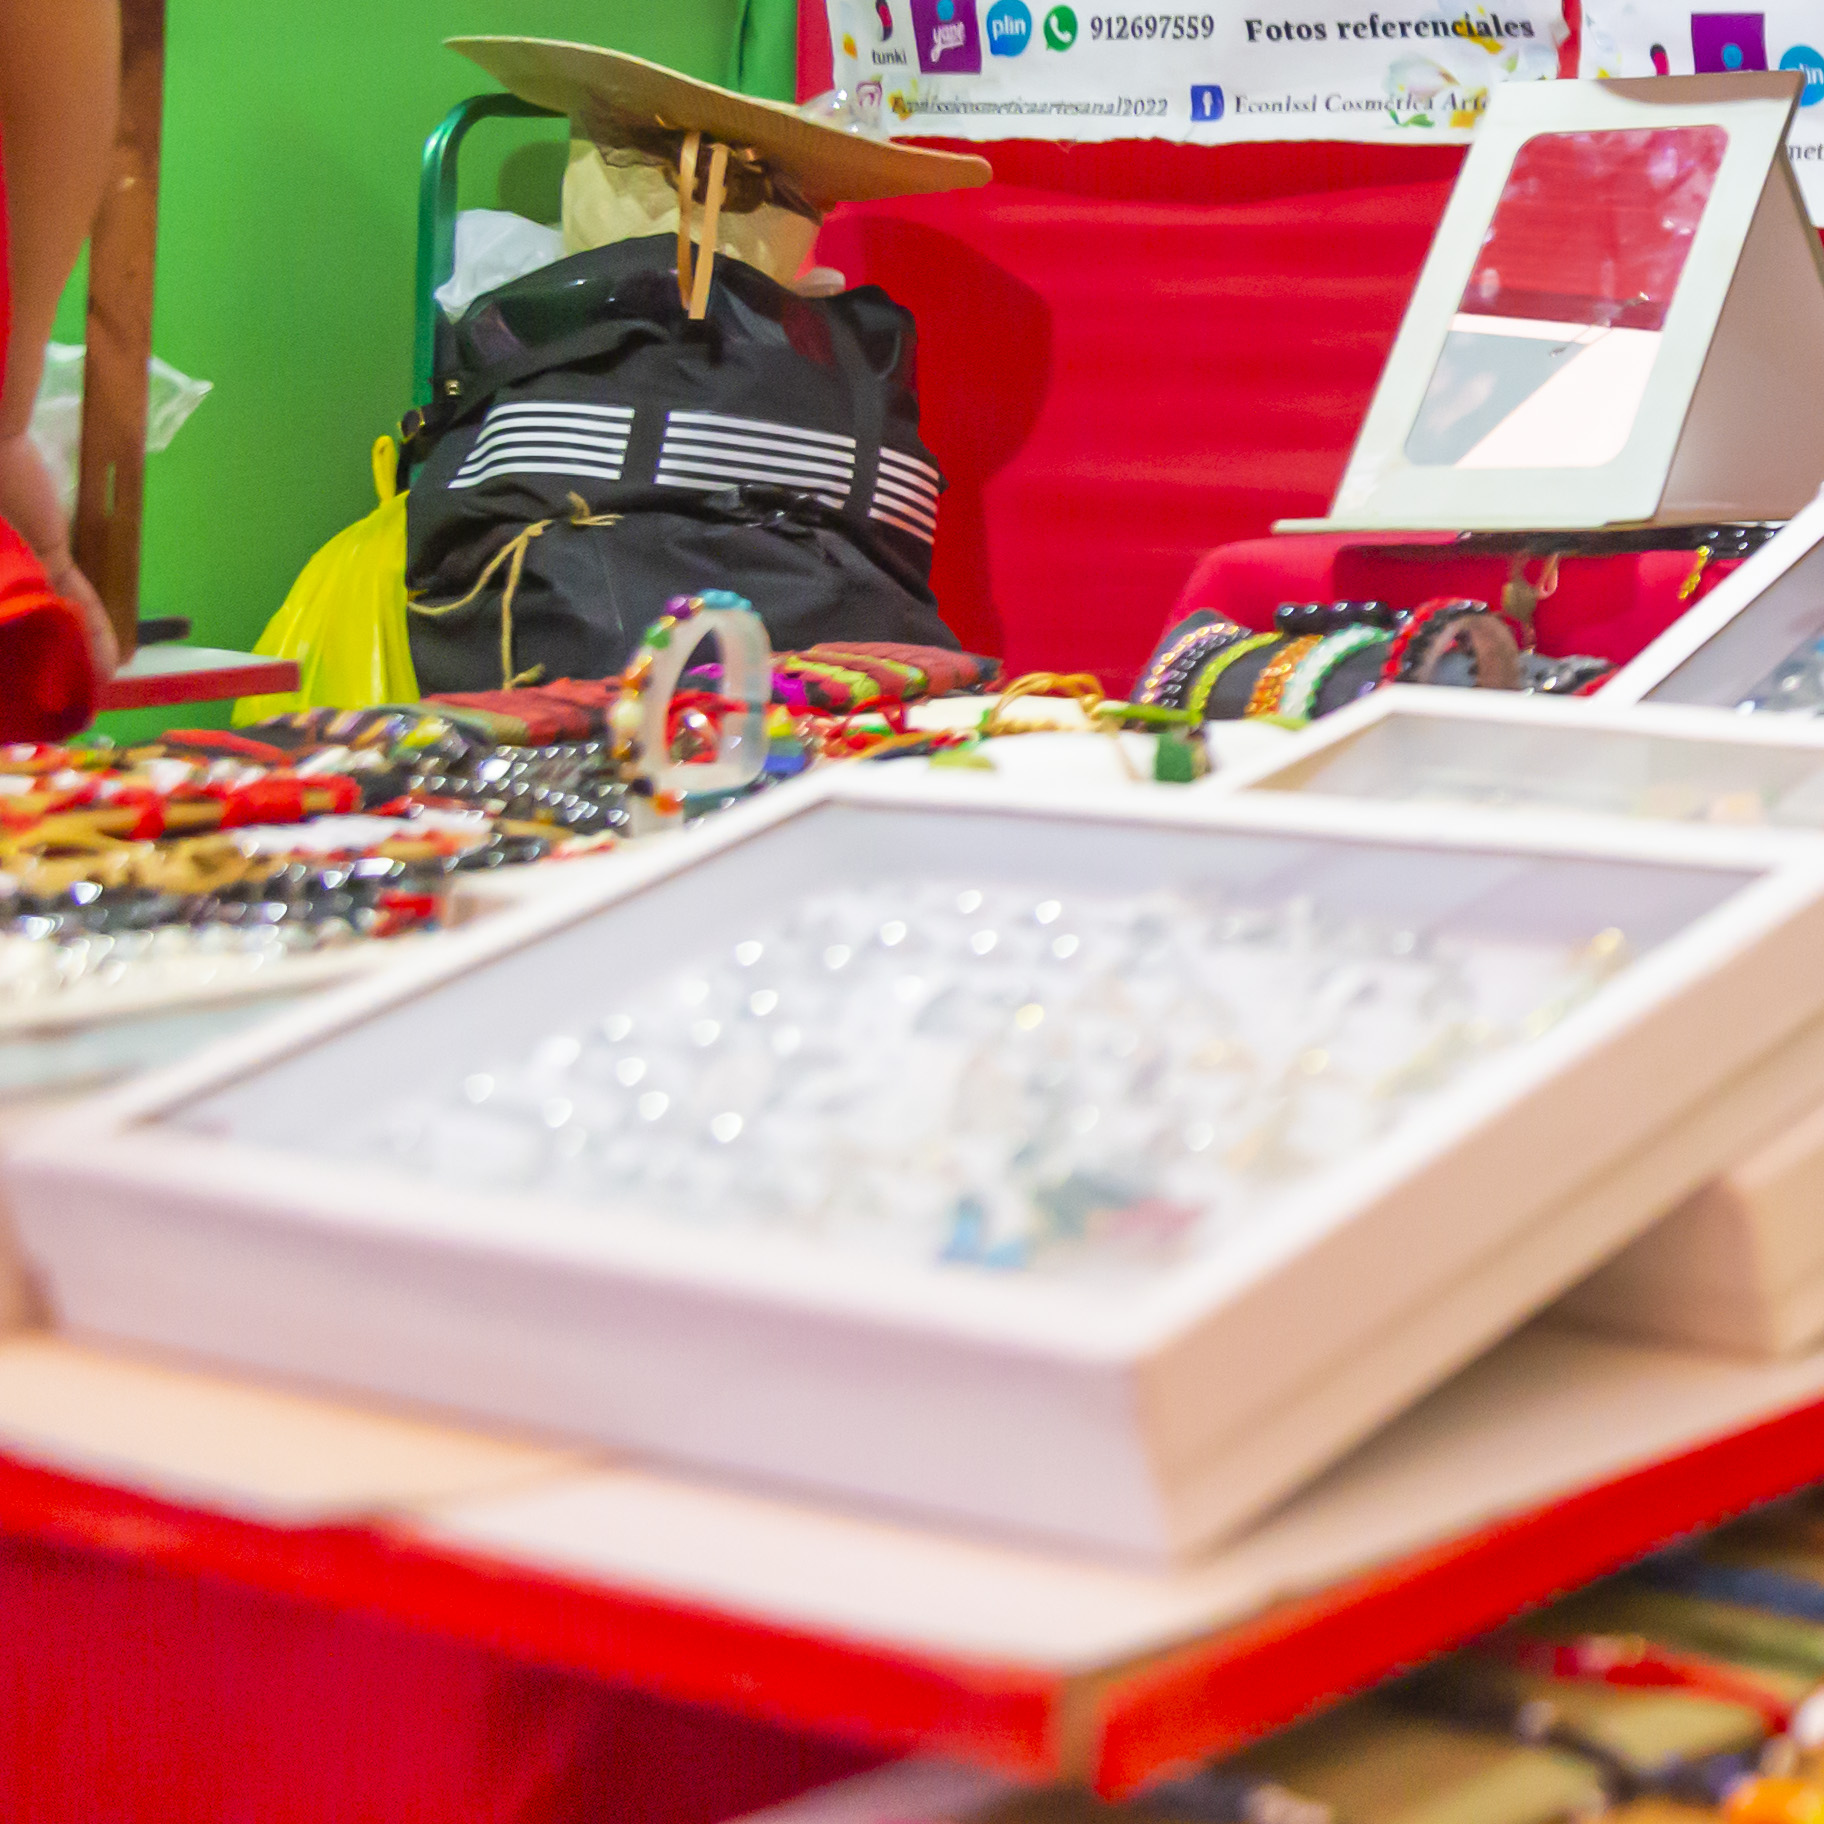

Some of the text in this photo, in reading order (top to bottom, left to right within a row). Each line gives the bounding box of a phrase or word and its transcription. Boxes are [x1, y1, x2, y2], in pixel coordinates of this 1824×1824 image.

[991, 14, 1027, 41] plin
[1090, 12, 1536, 43] 912697559 Fotos referenciales
[872, 48, 907, 66] tunki
